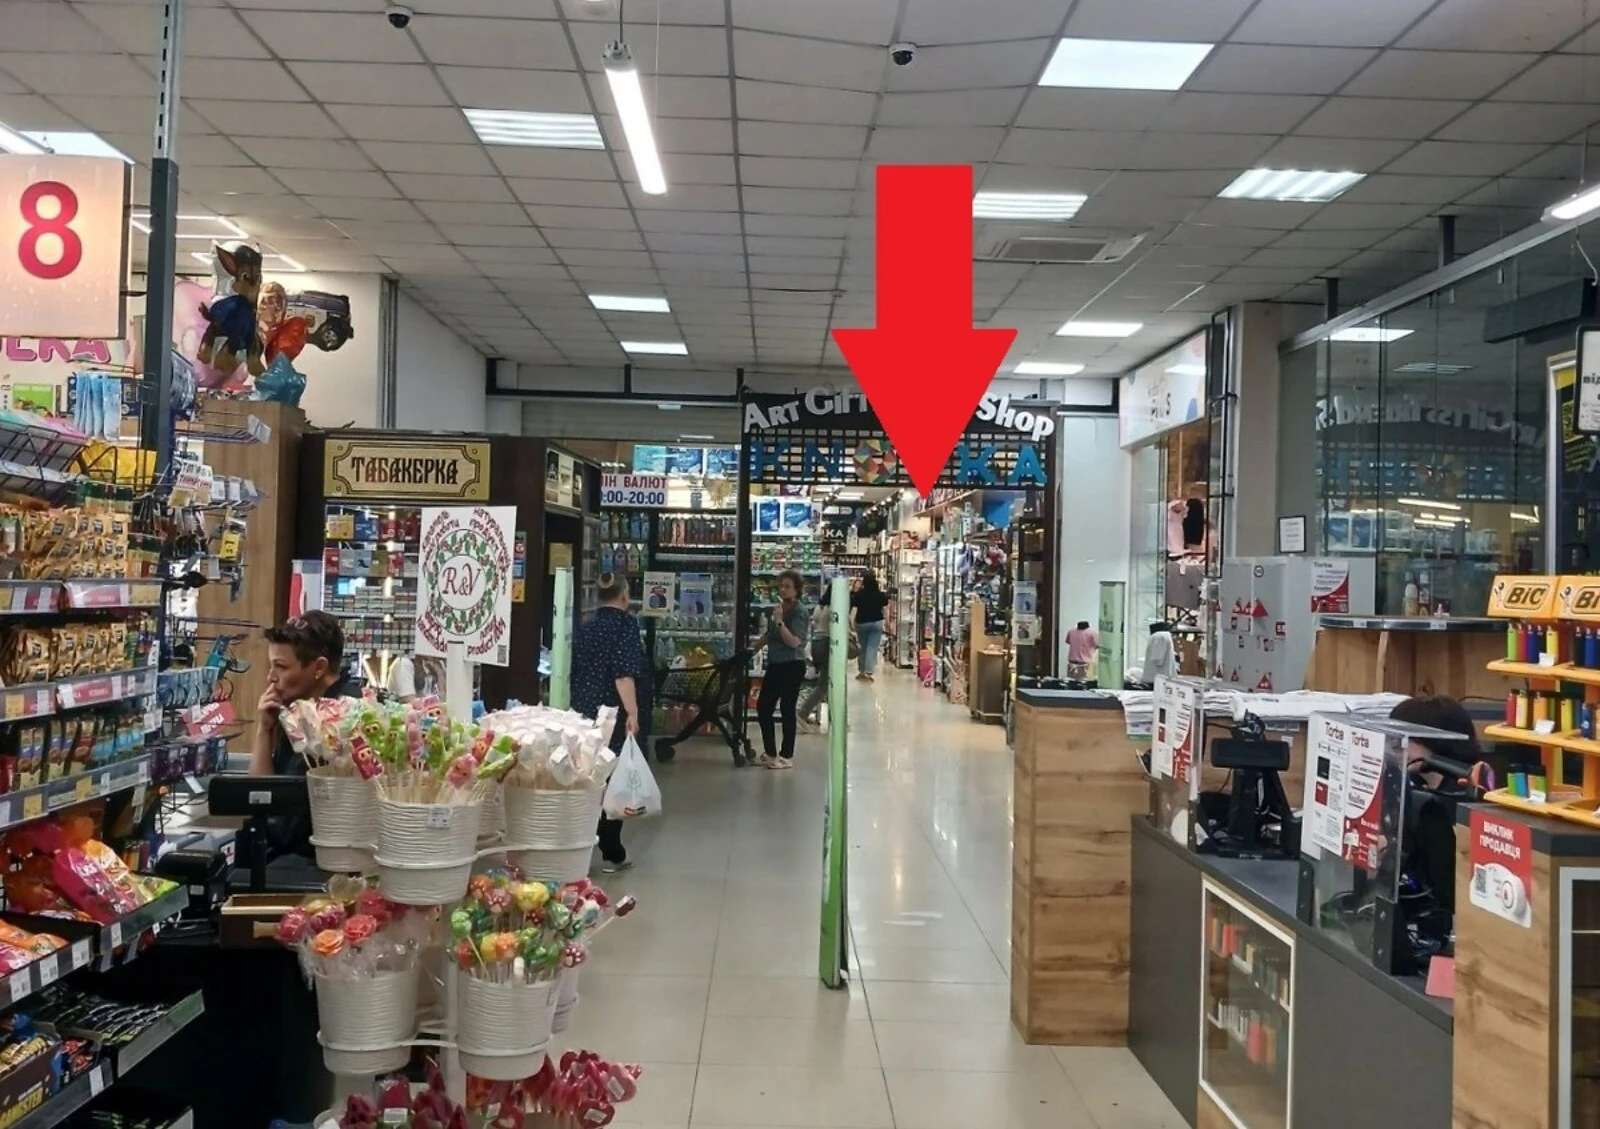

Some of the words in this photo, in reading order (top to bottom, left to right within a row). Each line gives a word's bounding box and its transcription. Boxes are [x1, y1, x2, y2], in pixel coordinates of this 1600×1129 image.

[18, 180, 83, 280] 8
[975, 391, 1055, 442] Shop
[351, 456, 458, 485] ТАБАКЕРКА
[623, 476, 667, 489] ВАЛЮТ
[1325, 721, 1344, 741] Torba
[1351, 731, 1370, 749] Torba
[1479, 834, 1521, 860] ПРОДАВЦЯ
